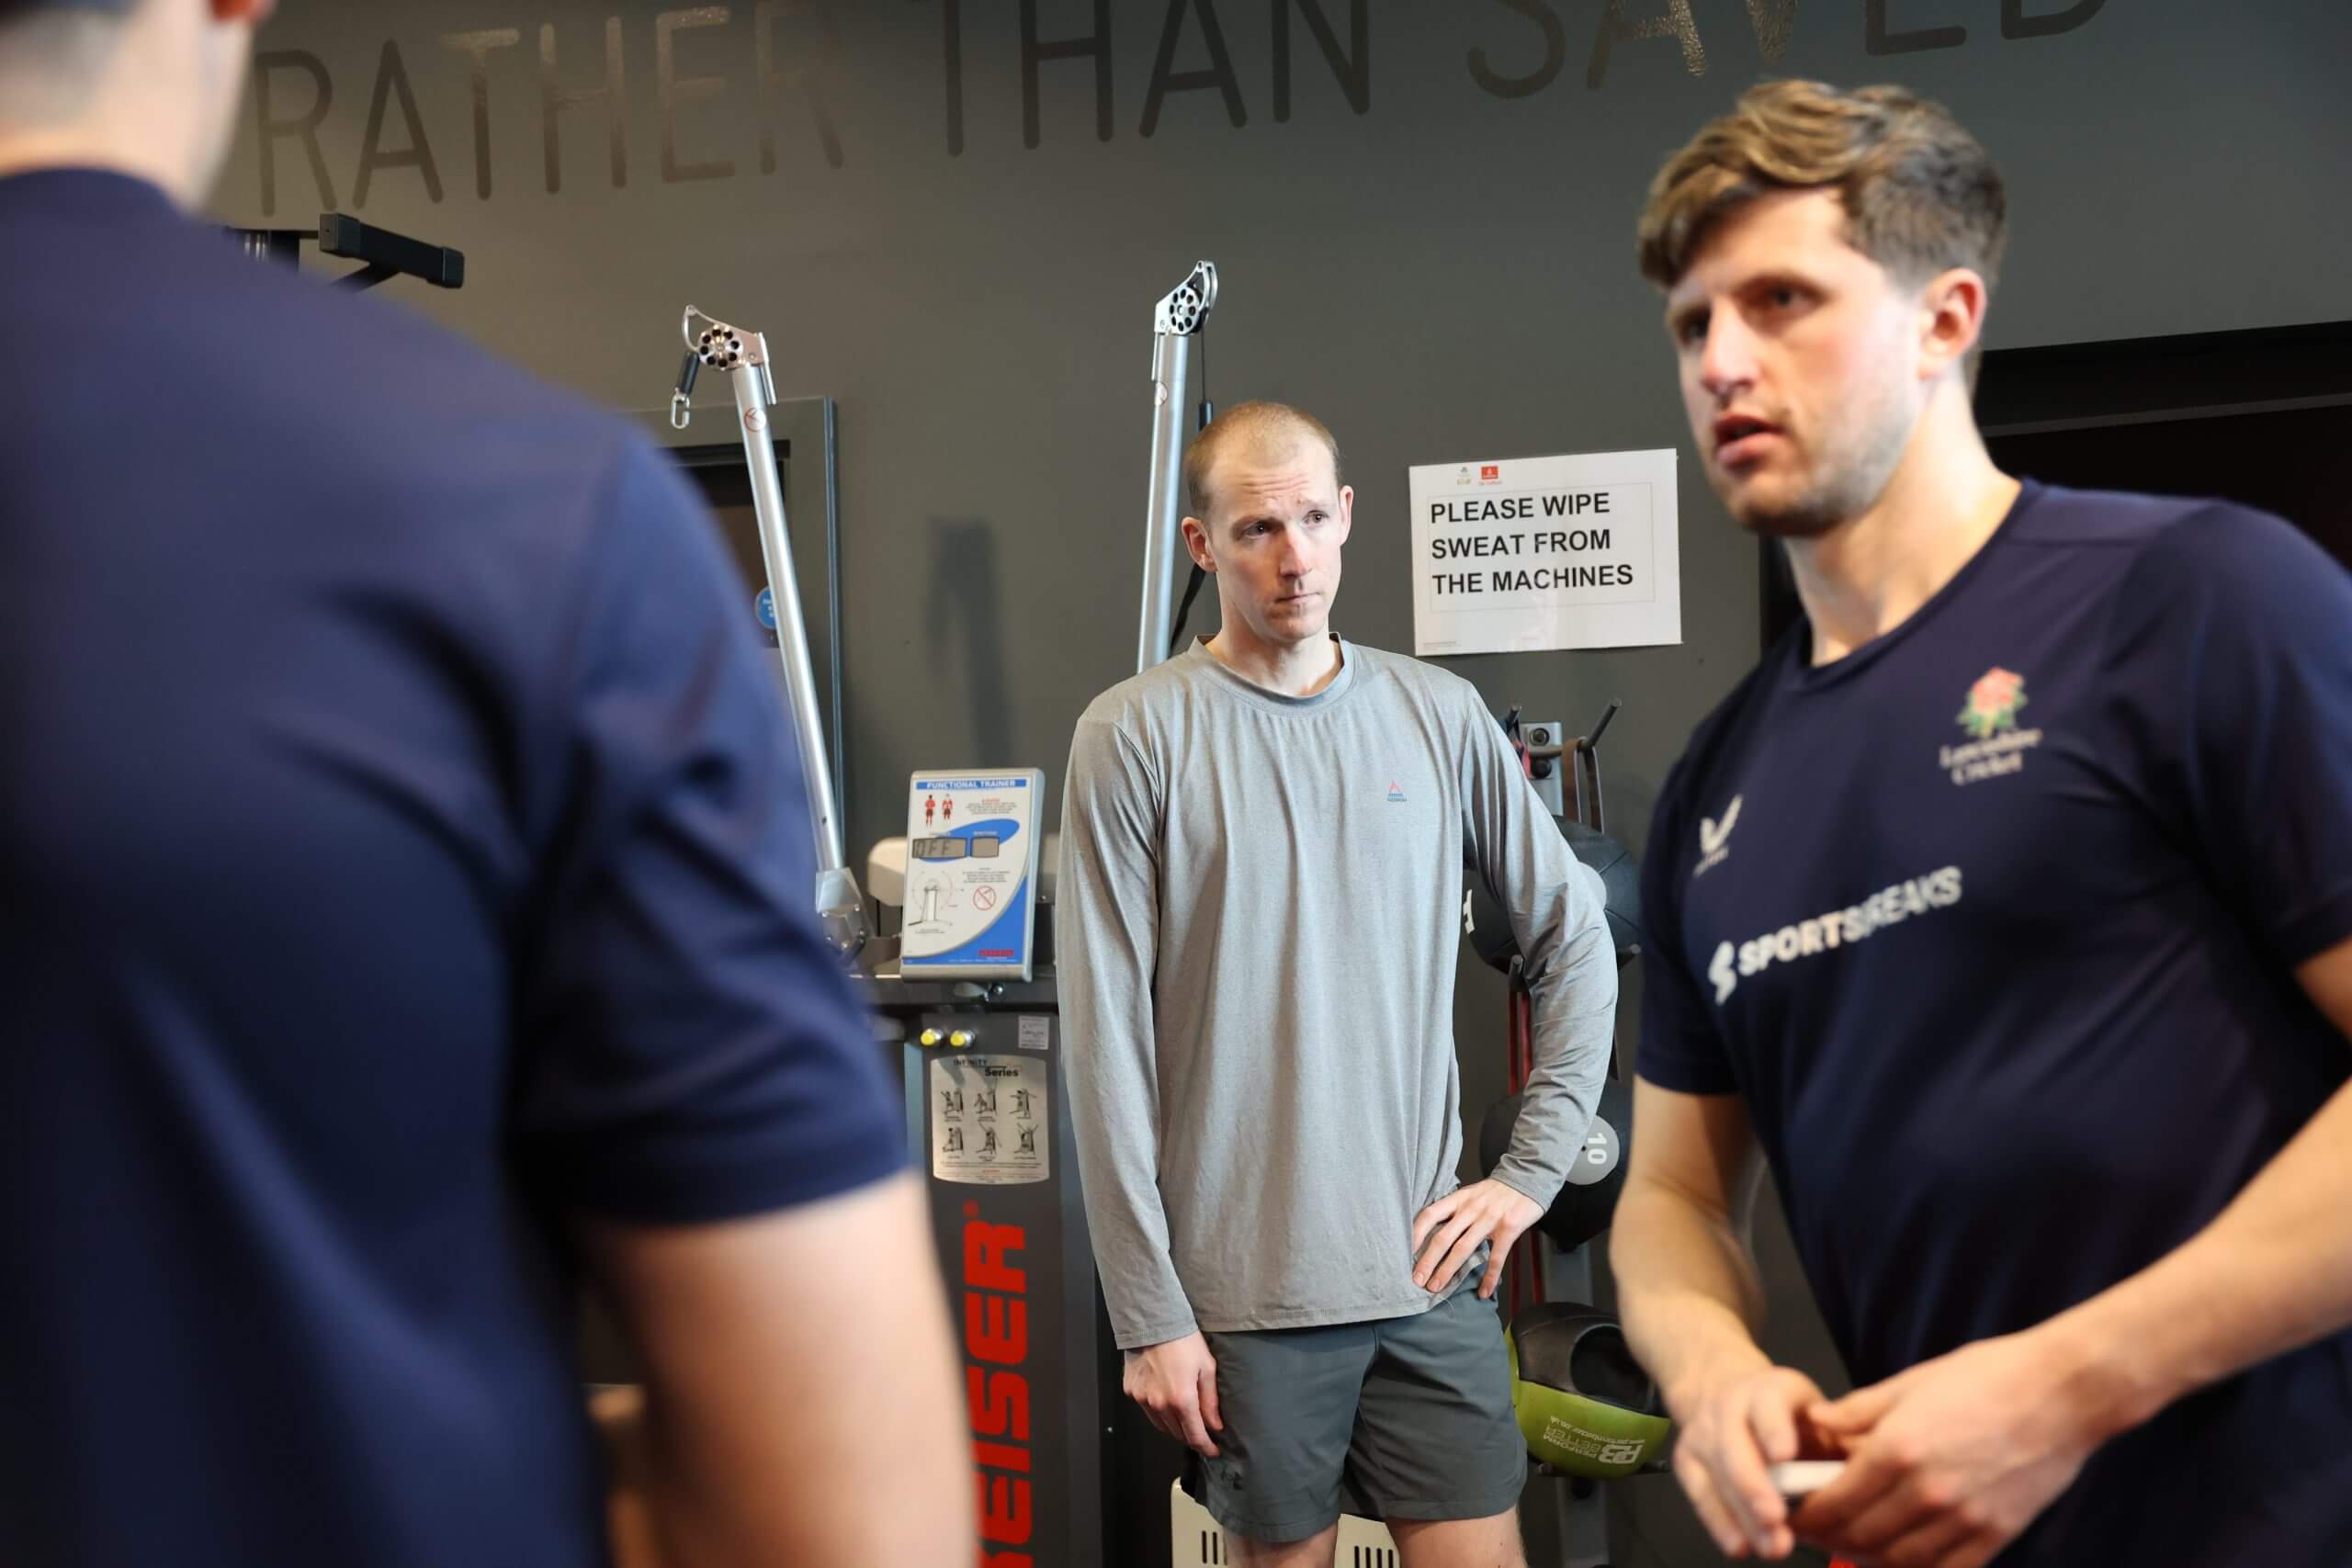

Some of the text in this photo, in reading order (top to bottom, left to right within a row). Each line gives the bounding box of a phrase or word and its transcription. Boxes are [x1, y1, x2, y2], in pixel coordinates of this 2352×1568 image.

[254, 4, 844, 217] RATHER
[1430, 492, 1611, 524] PLEASE WIPE
[1431, 528, 1611, 559] SWEAT FROM
[1432, 564, 1634, 594] THE MACHINES
[926, 779, 1016, 789] FUNCTIONAL TRAINER
[985, 1066, 1019, 1077] Series
[1587, 1132, 1607, 1165] 10
[963, 1219, 1034, 1568] EISER
[1546, 1425, 1601, 1452] BETTER
